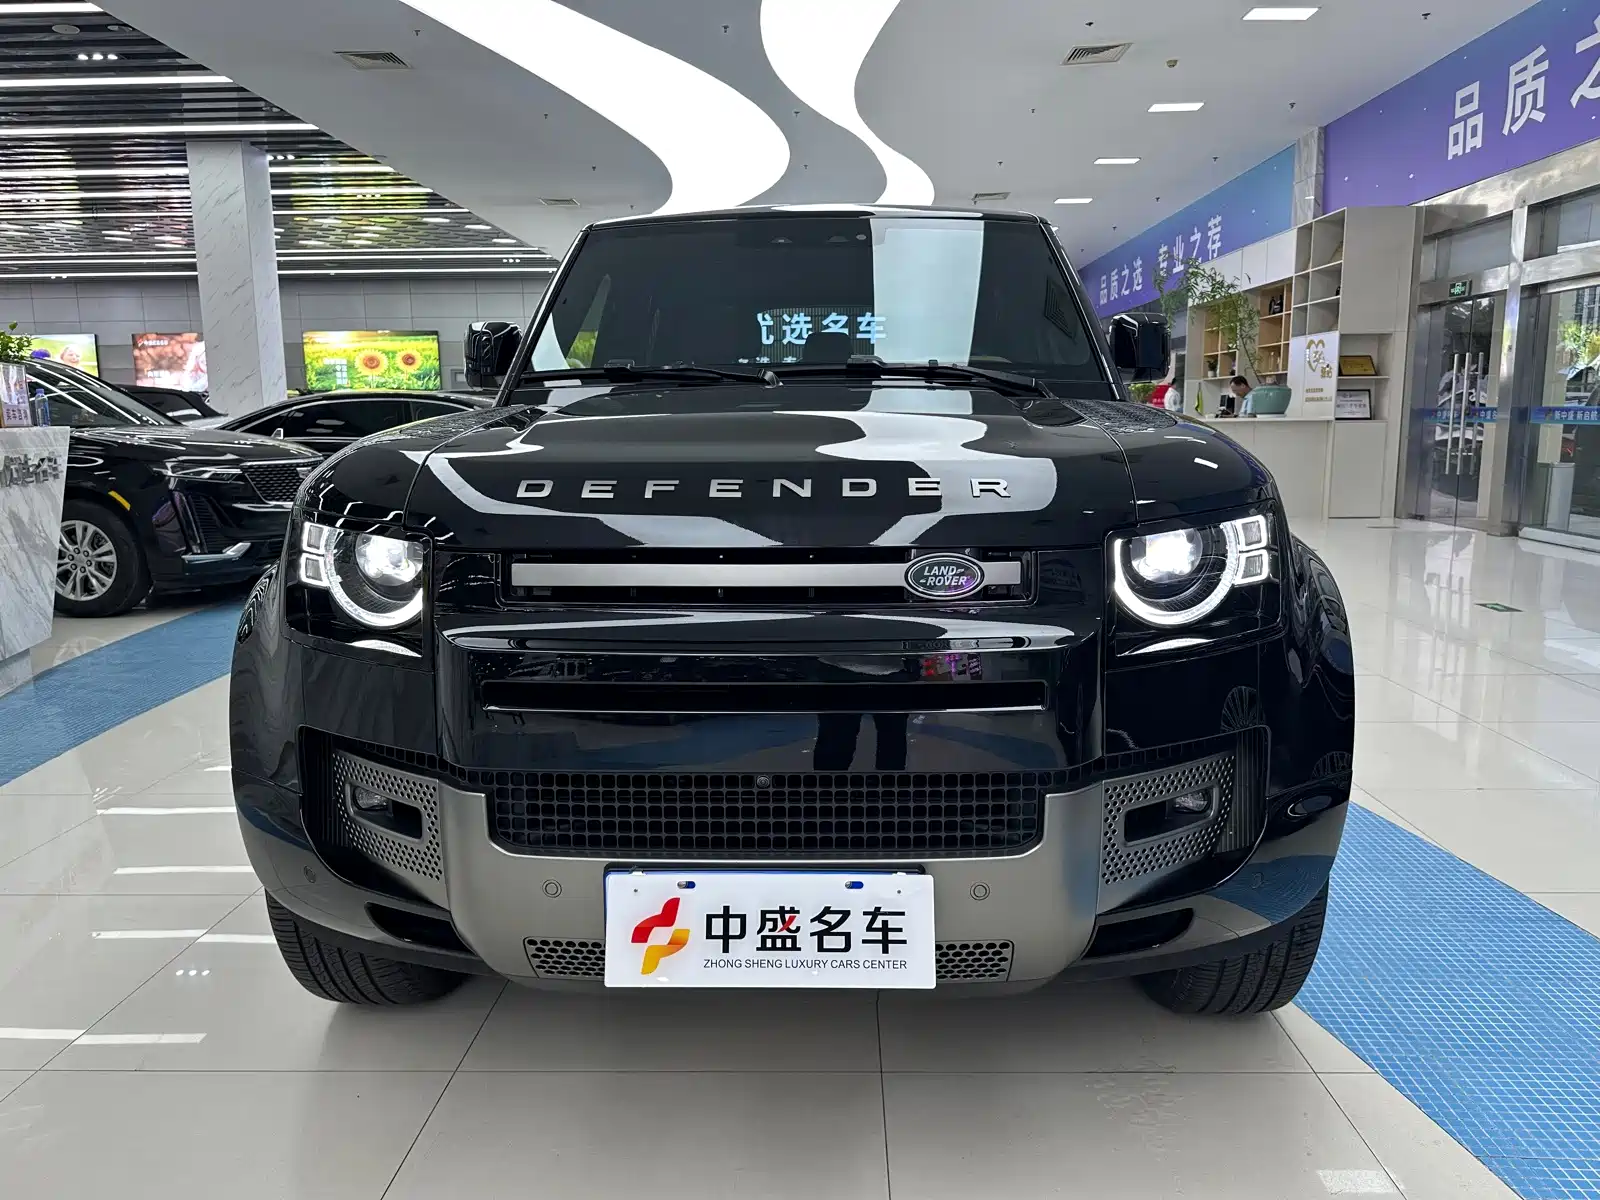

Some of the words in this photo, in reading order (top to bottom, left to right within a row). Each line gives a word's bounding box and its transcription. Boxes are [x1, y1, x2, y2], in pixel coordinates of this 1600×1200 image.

[1100, 256, 1143, 305] 品质之选
[1158, 214, 1222, 276] 专业之荐
[516, 477, 1012, 499] DEFENDER
[923, 565, 957, 576] LAND
[926, 576, 967, 586] ROVER
[705, 905, 907, 954] 中盛名车
[703, 959, 742, 969] ZHONG
[744, 959, 783, 969] SHENG
[785, 959, 829, 969] LUXURY
[830, 959, 861, 969] CARS
[862, 959, 907, 969] CENTER
